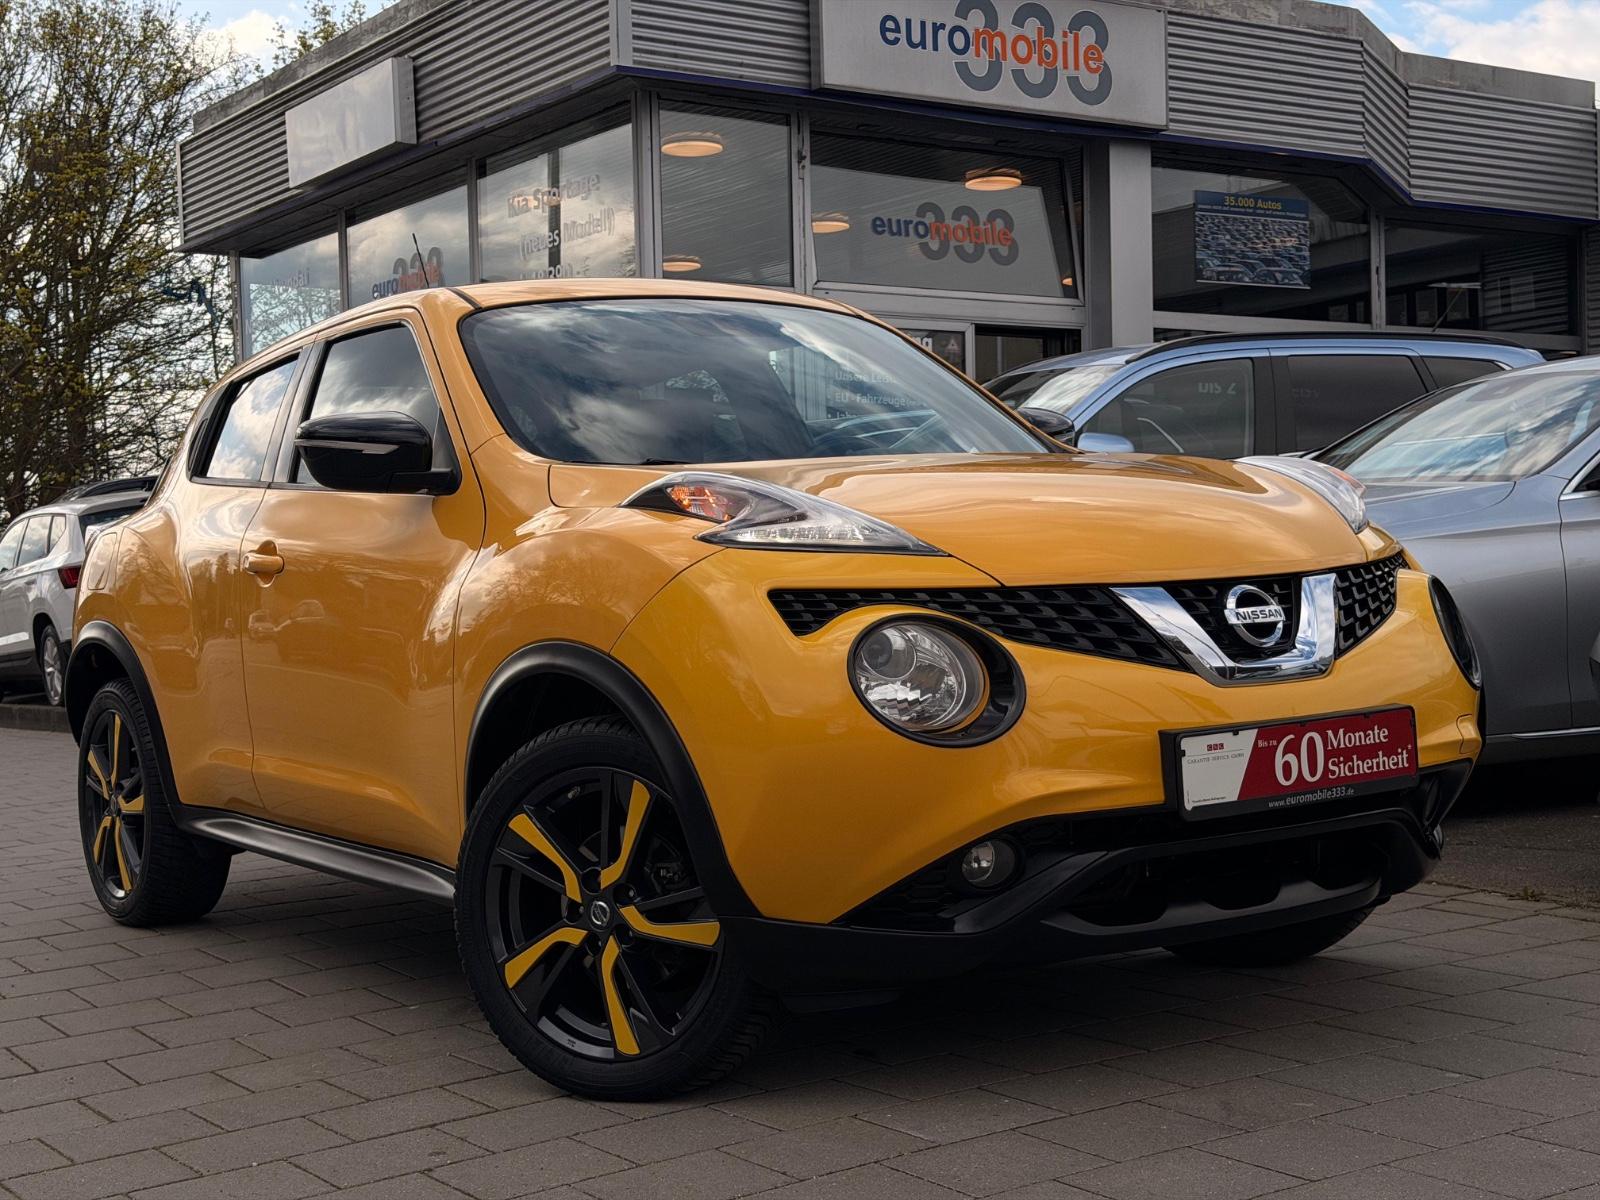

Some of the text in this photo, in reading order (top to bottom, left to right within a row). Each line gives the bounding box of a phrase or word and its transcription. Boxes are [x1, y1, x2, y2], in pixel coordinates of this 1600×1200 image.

[879, 14, 1104, 75] euromobile
[953, 0, 1113, 106] 333
[533, 173, 601, 214] Sportage
[1223, 195, 1255, 208] 35.000
[1256, 198, 1283, 211] Autos
[871, 215, 1014, 247] euromobile
[914, 202, 1019, 266] 333
[1235, 608, 1283, 621] NISSAN
[1326, 724, 1389, 750] Monate
[1274, 731, 1325, 787] 60
[1268, 786, 1355, 808] www.euromobile333.de
